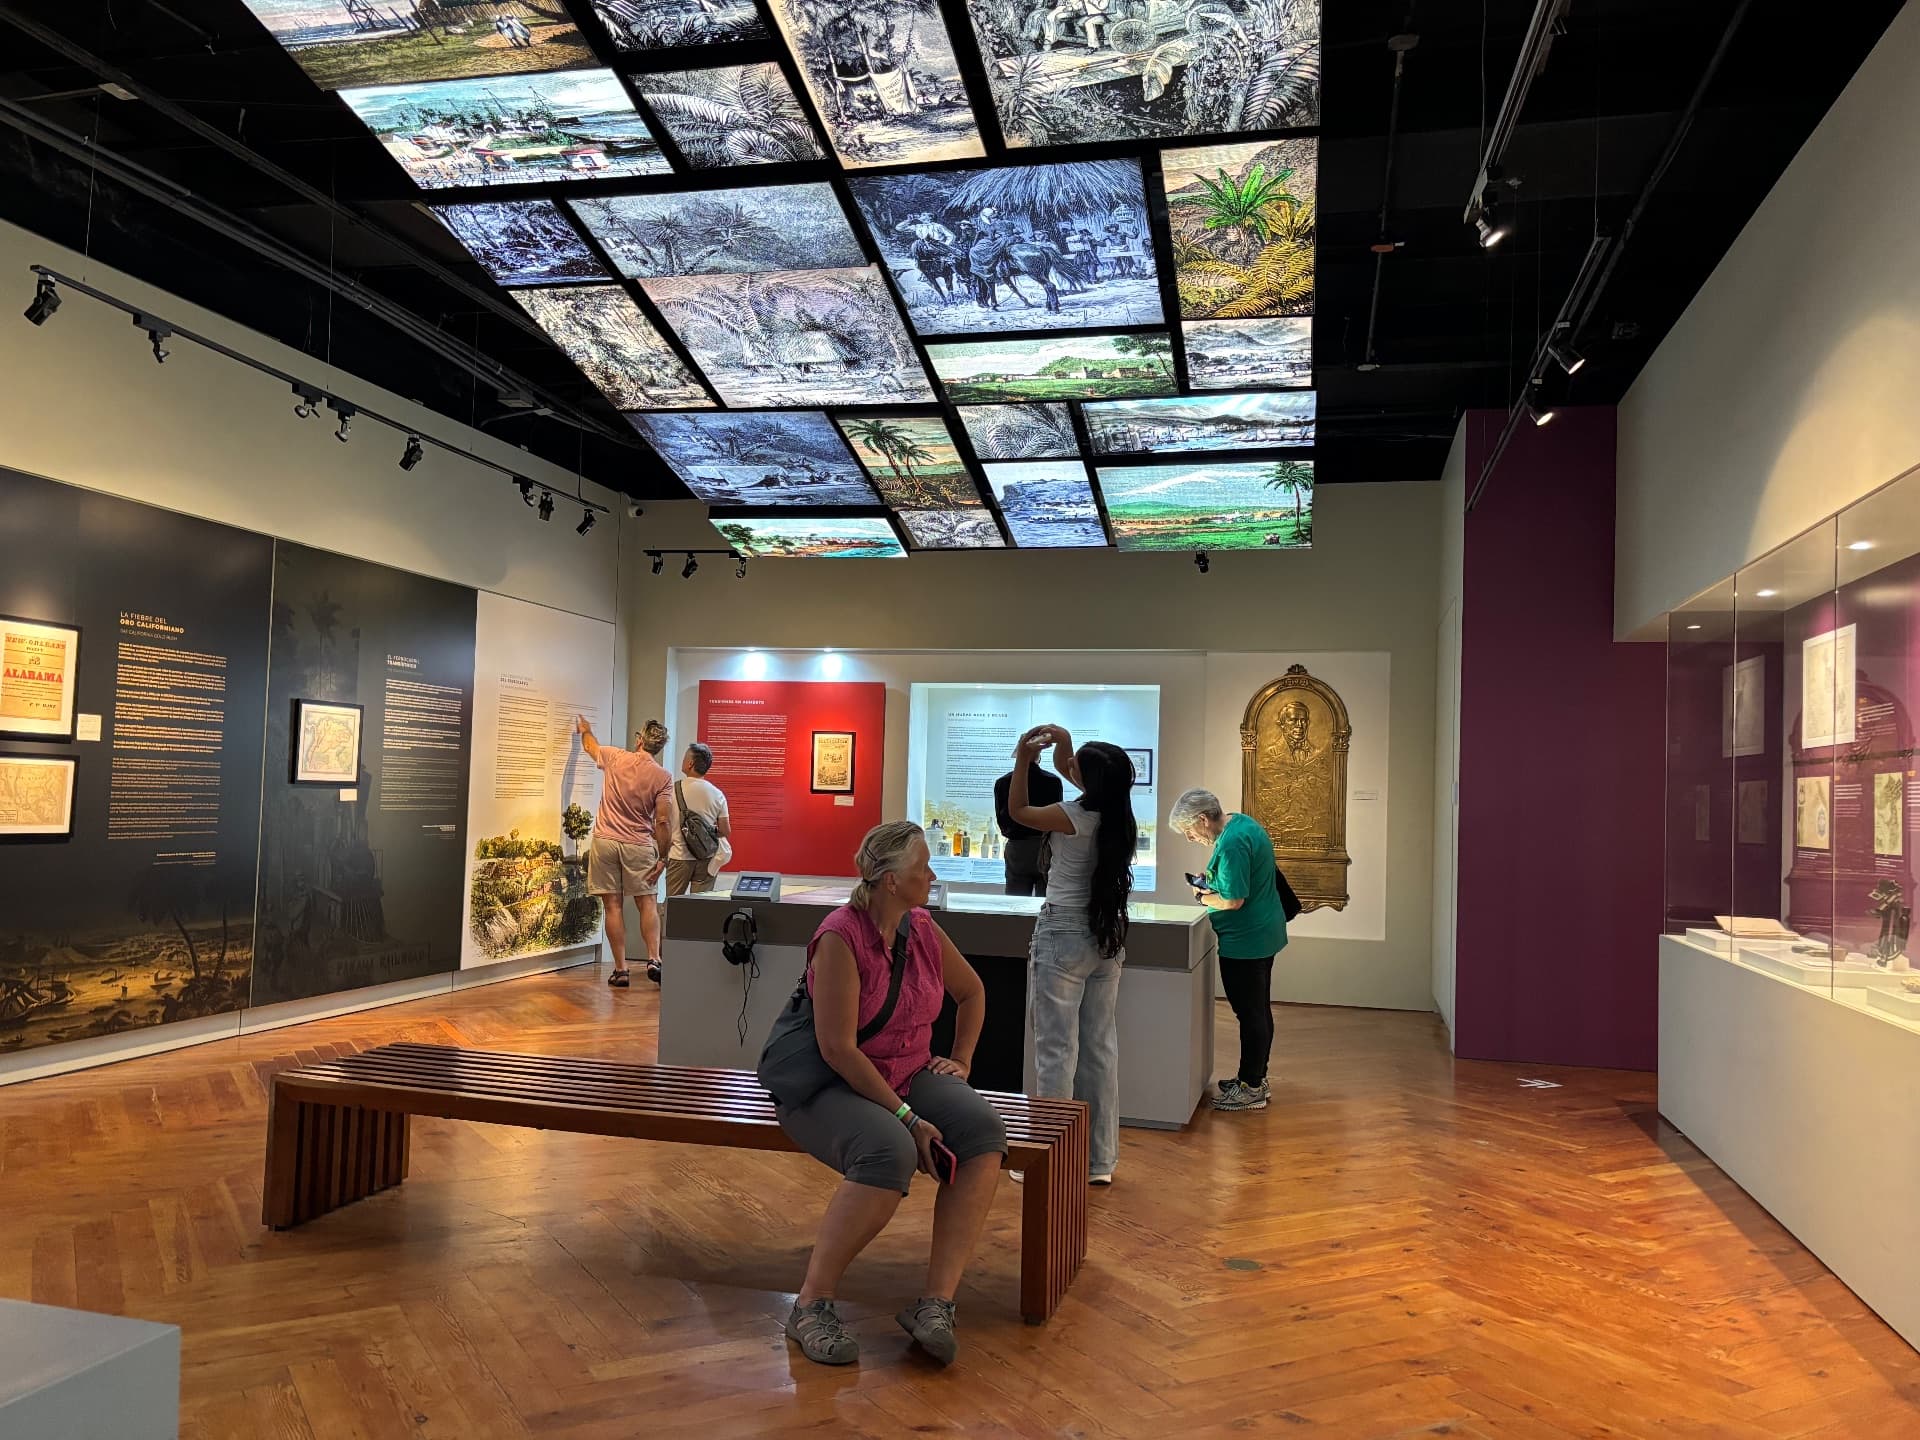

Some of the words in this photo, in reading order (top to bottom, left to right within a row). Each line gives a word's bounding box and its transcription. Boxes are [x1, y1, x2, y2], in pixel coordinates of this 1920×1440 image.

[120, 618, 135, 626] ORO
[136, 621, 185, 634] CALIFORNIANO
[130, 613, 153, 622] FIEBRE
[155, 616, 168, 624] DEL
[4, 667, 64, 683] ALABAMA
